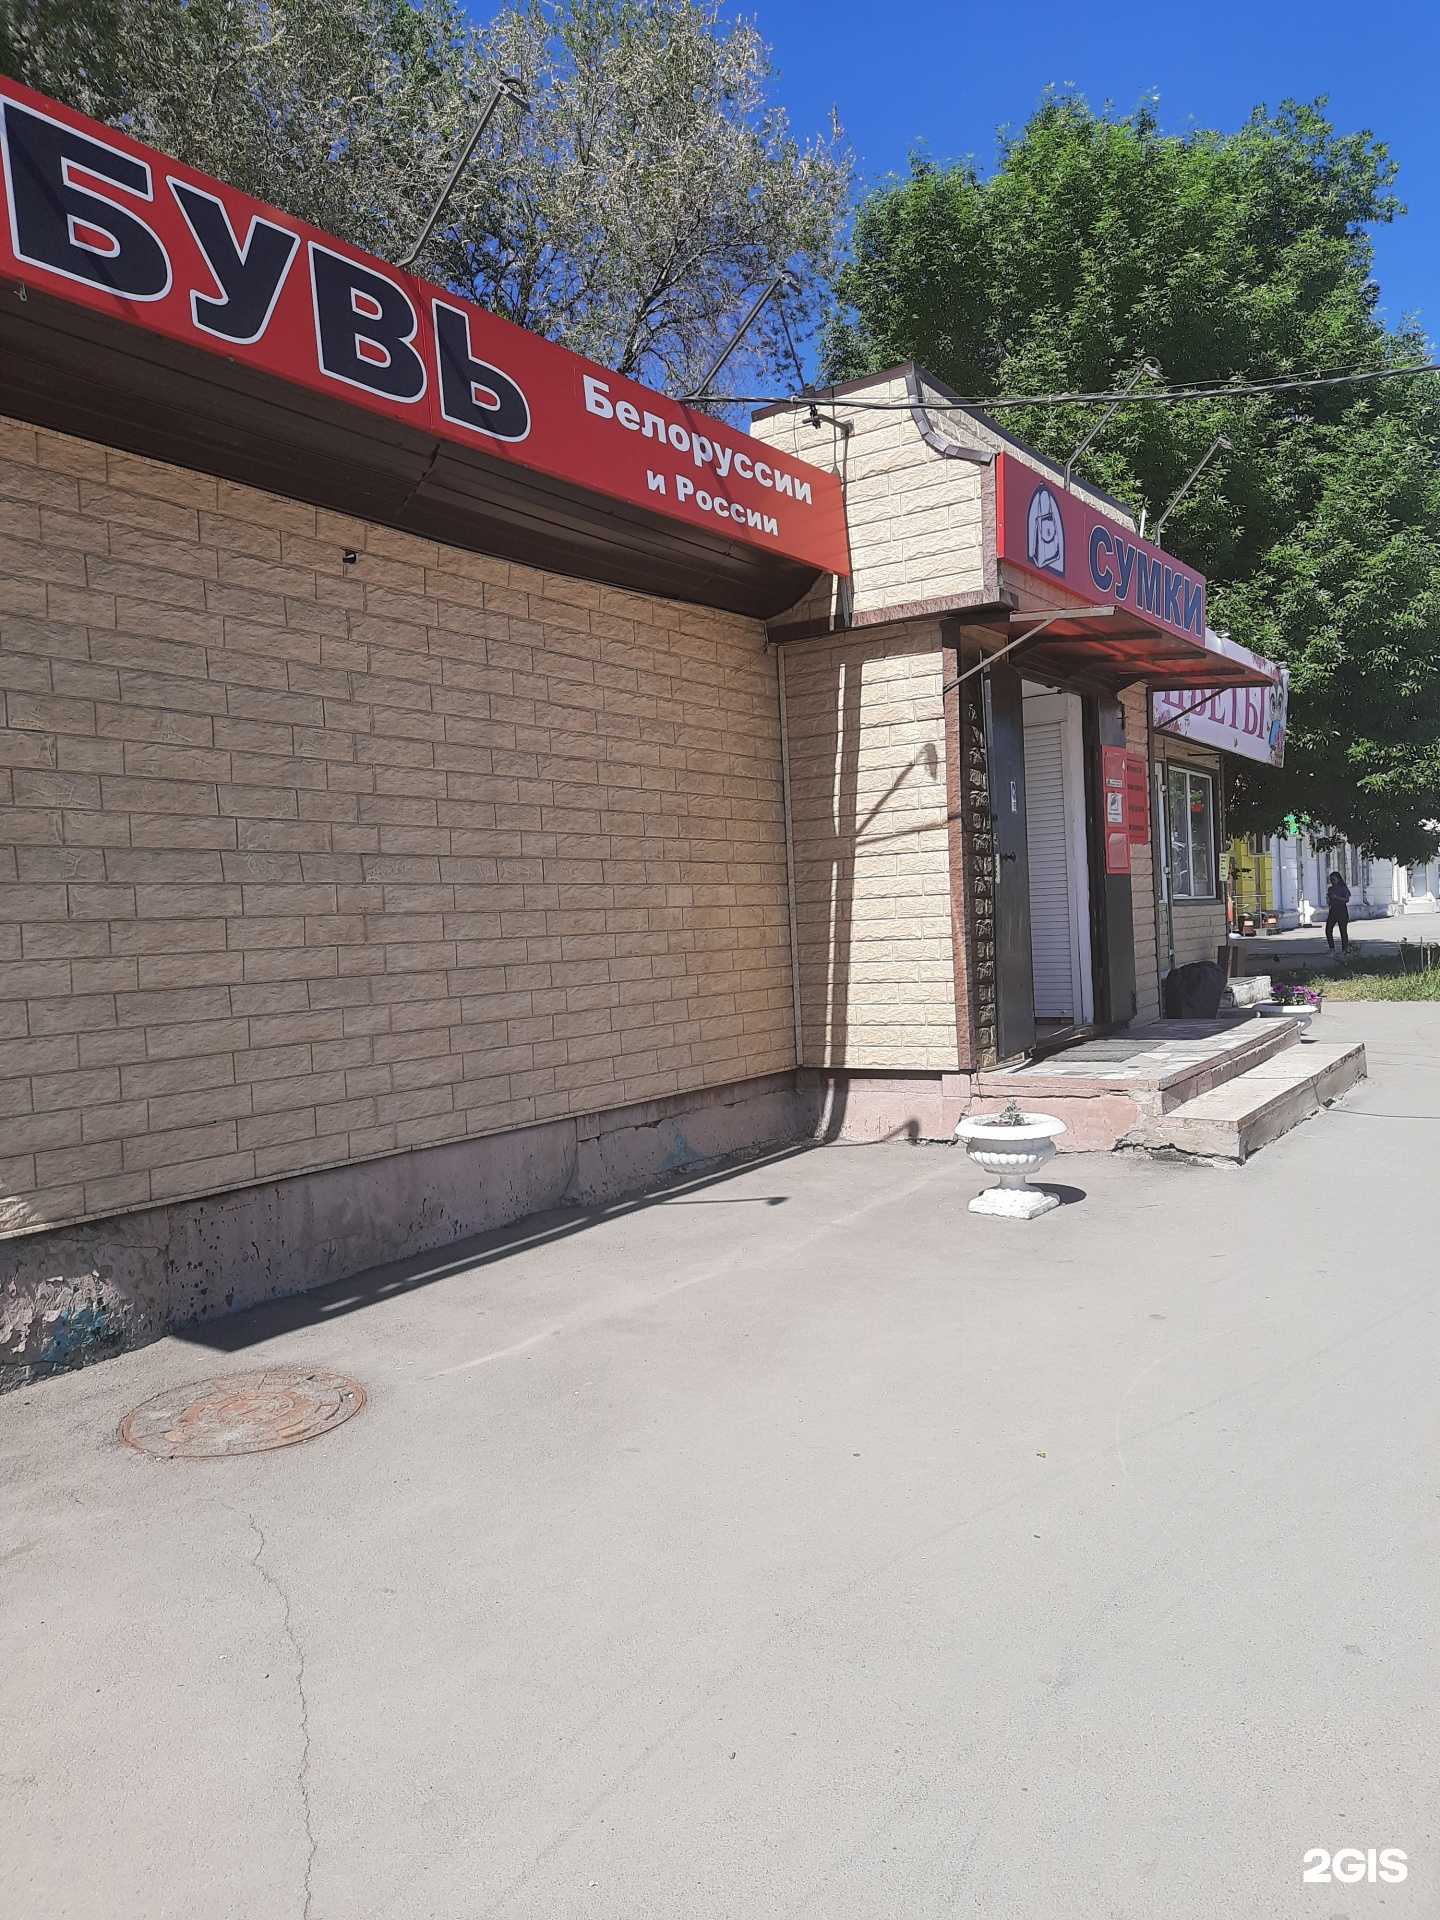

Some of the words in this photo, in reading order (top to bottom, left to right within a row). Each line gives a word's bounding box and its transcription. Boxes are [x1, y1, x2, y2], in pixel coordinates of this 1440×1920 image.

[0, 95, 531, 442] БУВЬ
[583, 374, 812, 504] Белоруссии
[647, 470, 666, 495] и
[676, 474, 779, 536] России
[1088, 525, 1203, 638] СУМКИ
